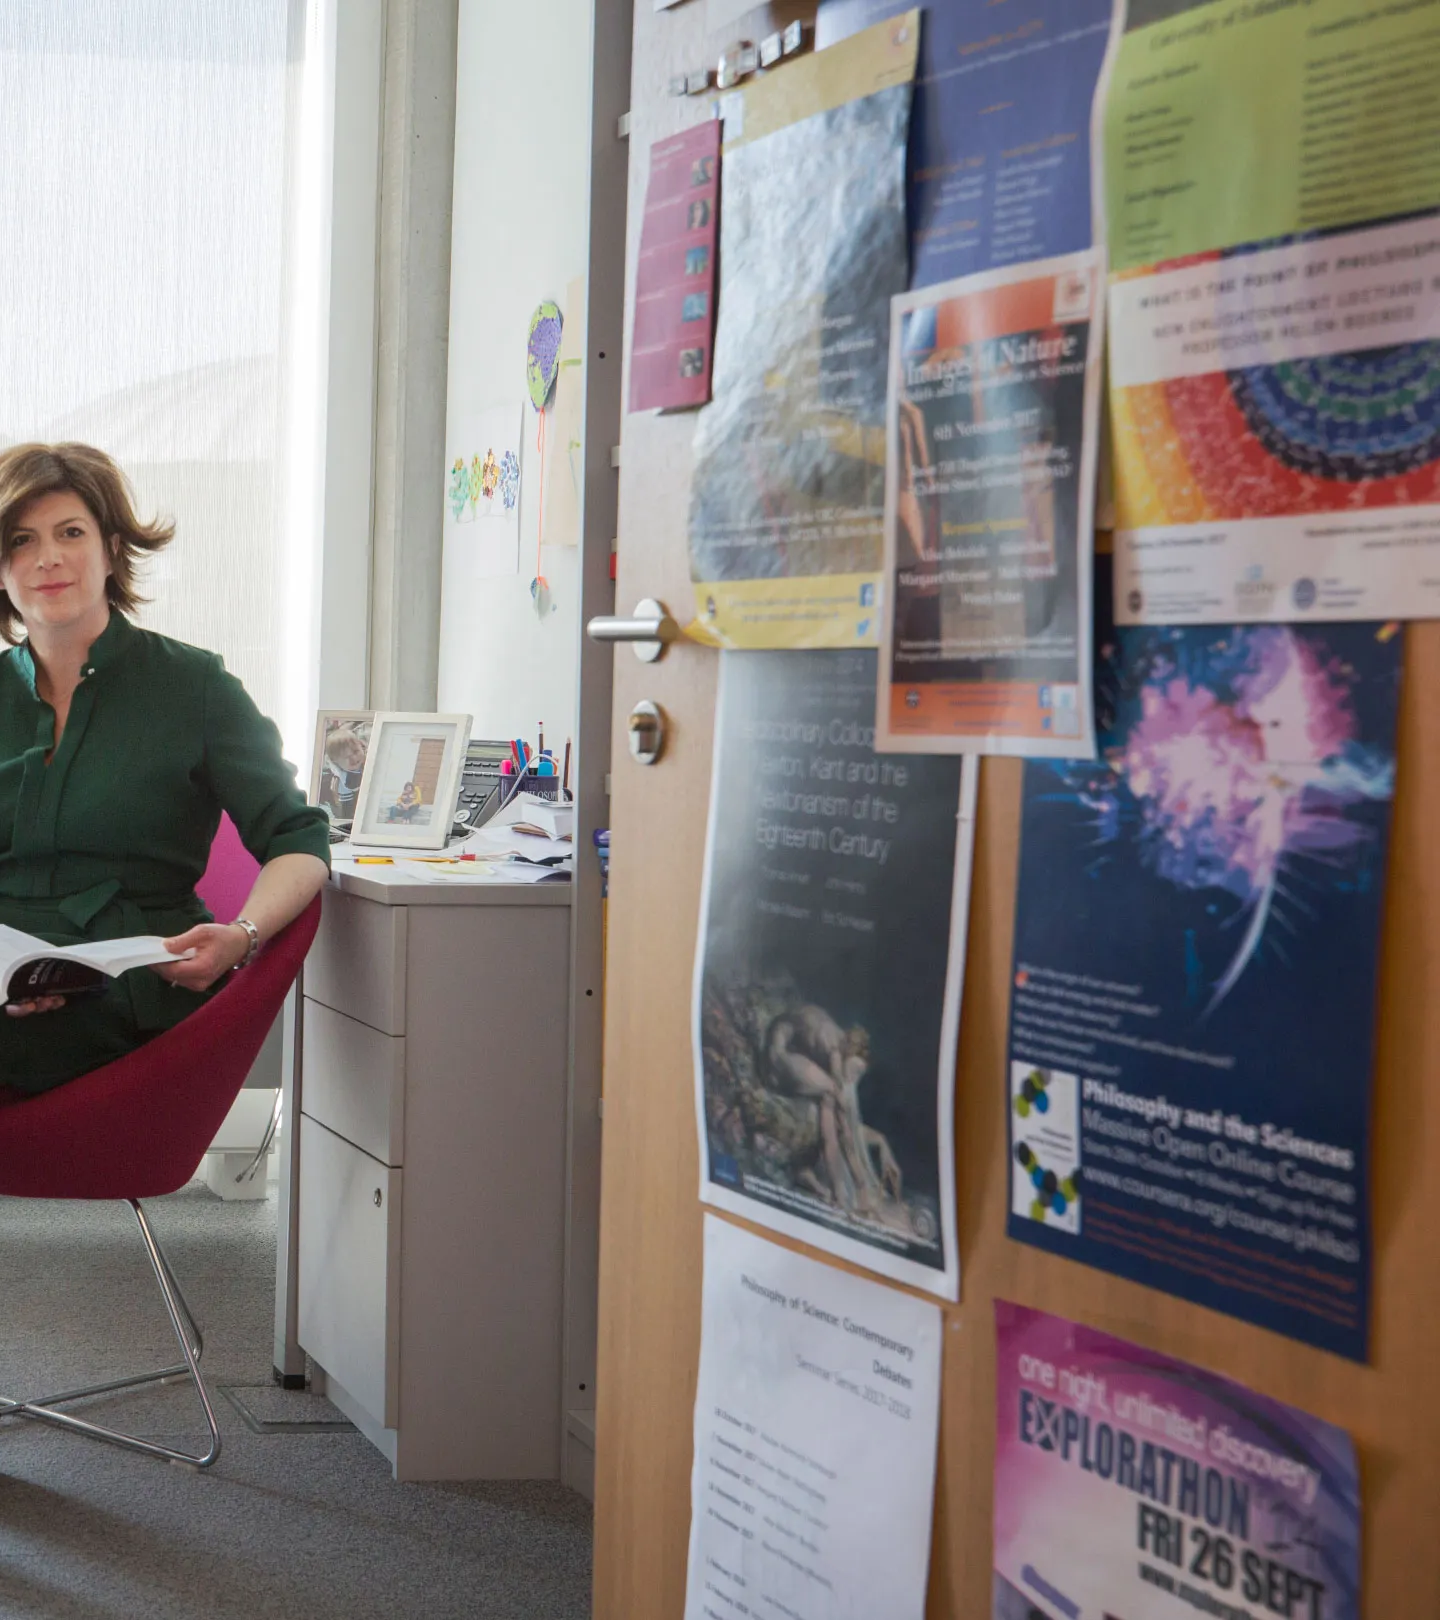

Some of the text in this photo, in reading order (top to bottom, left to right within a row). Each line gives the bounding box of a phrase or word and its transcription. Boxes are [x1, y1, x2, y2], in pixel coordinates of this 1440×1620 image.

[999, 334, 1078, 369] Nature
[846, 758, 878, 785] and
[880, 762, 910, 788] the
[851, 794, 870, 820] of
[871, 796, 900, 824] the
[755, 818, 892, 865] Eighteenth Century
[1082, 1076, 1356, 1172] Philosophy and the Sciences
[1082, 1106, 1357, 1205] Massive Open Online Course
[741, 1273, 788, 1308] Philosophy
[789, 1297, 801, 1310] of
[842, 1316, 916, 1362] Contemporary
[871, 1358, 914, 1390] Debates
[1018, 1352, 1056, 1389] one
[1113, 1386, 1209, 1451] unlimited
[1208, 1421, 1323, 1505] discovery
[1018, 1388, 1252, 1542] EXPLORATHON
[1136, 1499, 1185, 1569] FRI
[1190, 1525, 1237, 1591] 26
[1240, 1543, 1326, 1620] SEPT
